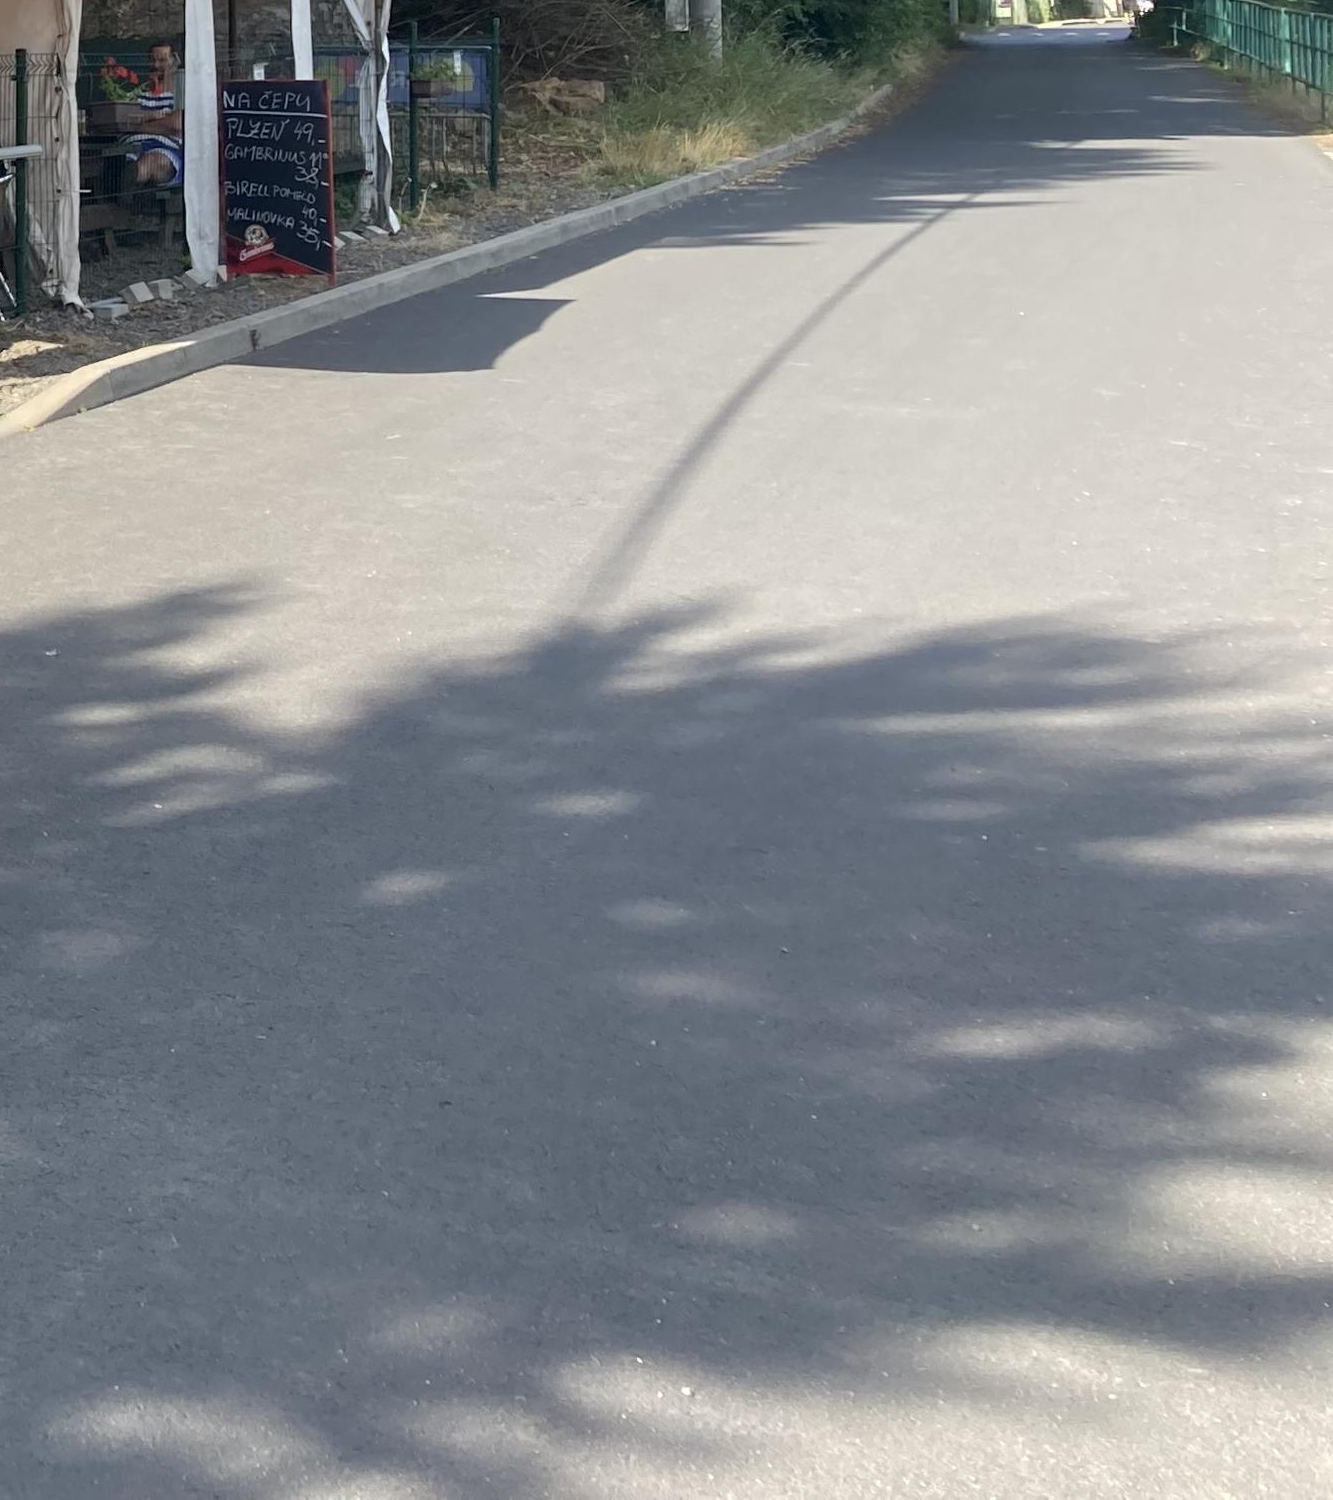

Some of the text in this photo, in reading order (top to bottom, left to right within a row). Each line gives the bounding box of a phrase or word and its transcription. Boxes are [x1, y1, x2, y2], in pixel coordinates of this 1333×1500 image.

[223, 90, 251, 109] NA
[225, 143, 306, 165] GAMBRINUS
[224, 180, 270, 197] BIRELL
[226, 206, 295, 229] MALINOVKA
